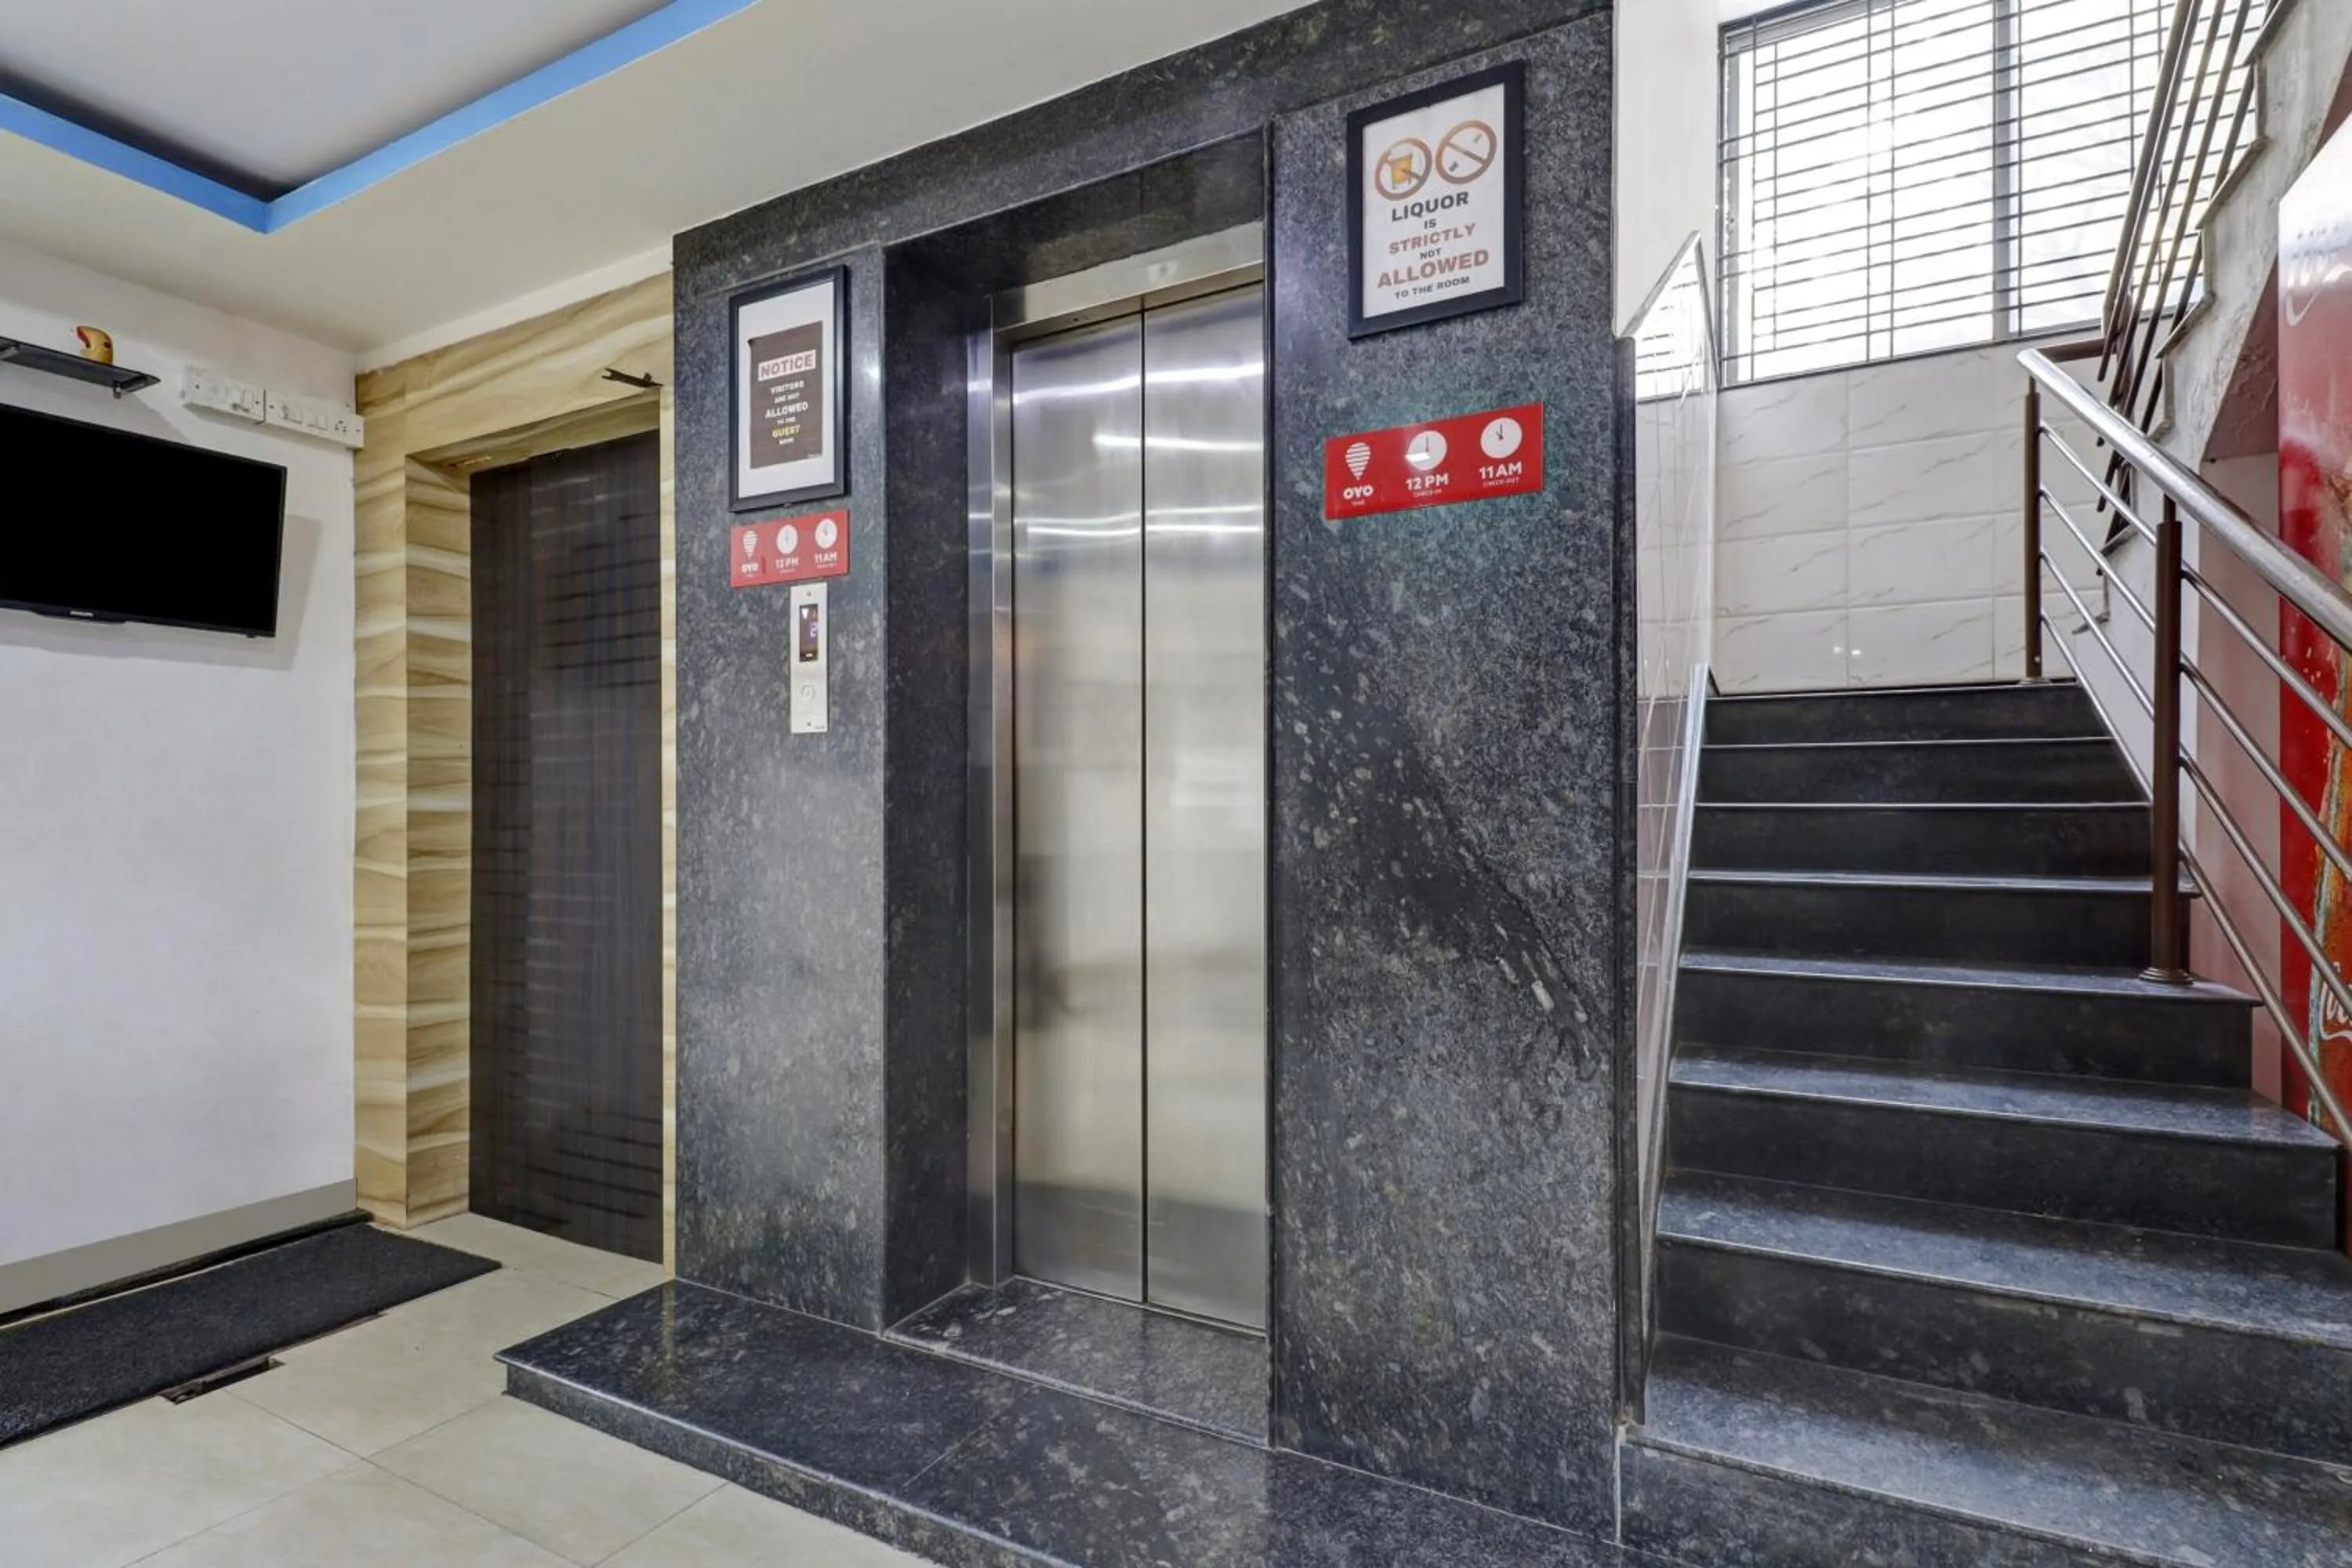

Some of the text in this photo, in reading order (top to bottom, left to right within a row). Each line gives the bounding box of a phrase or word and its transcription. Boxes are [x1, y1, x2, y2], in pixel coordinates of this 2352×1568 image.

[1392, 191, 1469, 222] LIQUOR
[1424, 219, 1437, 230] IS
[1389, 223, 1476, 255] STRICTLY
[1420, 248, 1441, 260] NOT
[1377, 249, 1490, 289] ALLOWED
[1395, 276, 1470, 299] TO THE ROOM
[761, 354, 813, 377] NOTICE
[765, 401, 808, 419] ALLOWED
[772, 424, 800, 438] GUEST
[1406, 474, 1449, 490] 12 PM
[1343, 485, 1374, 499] OYO
